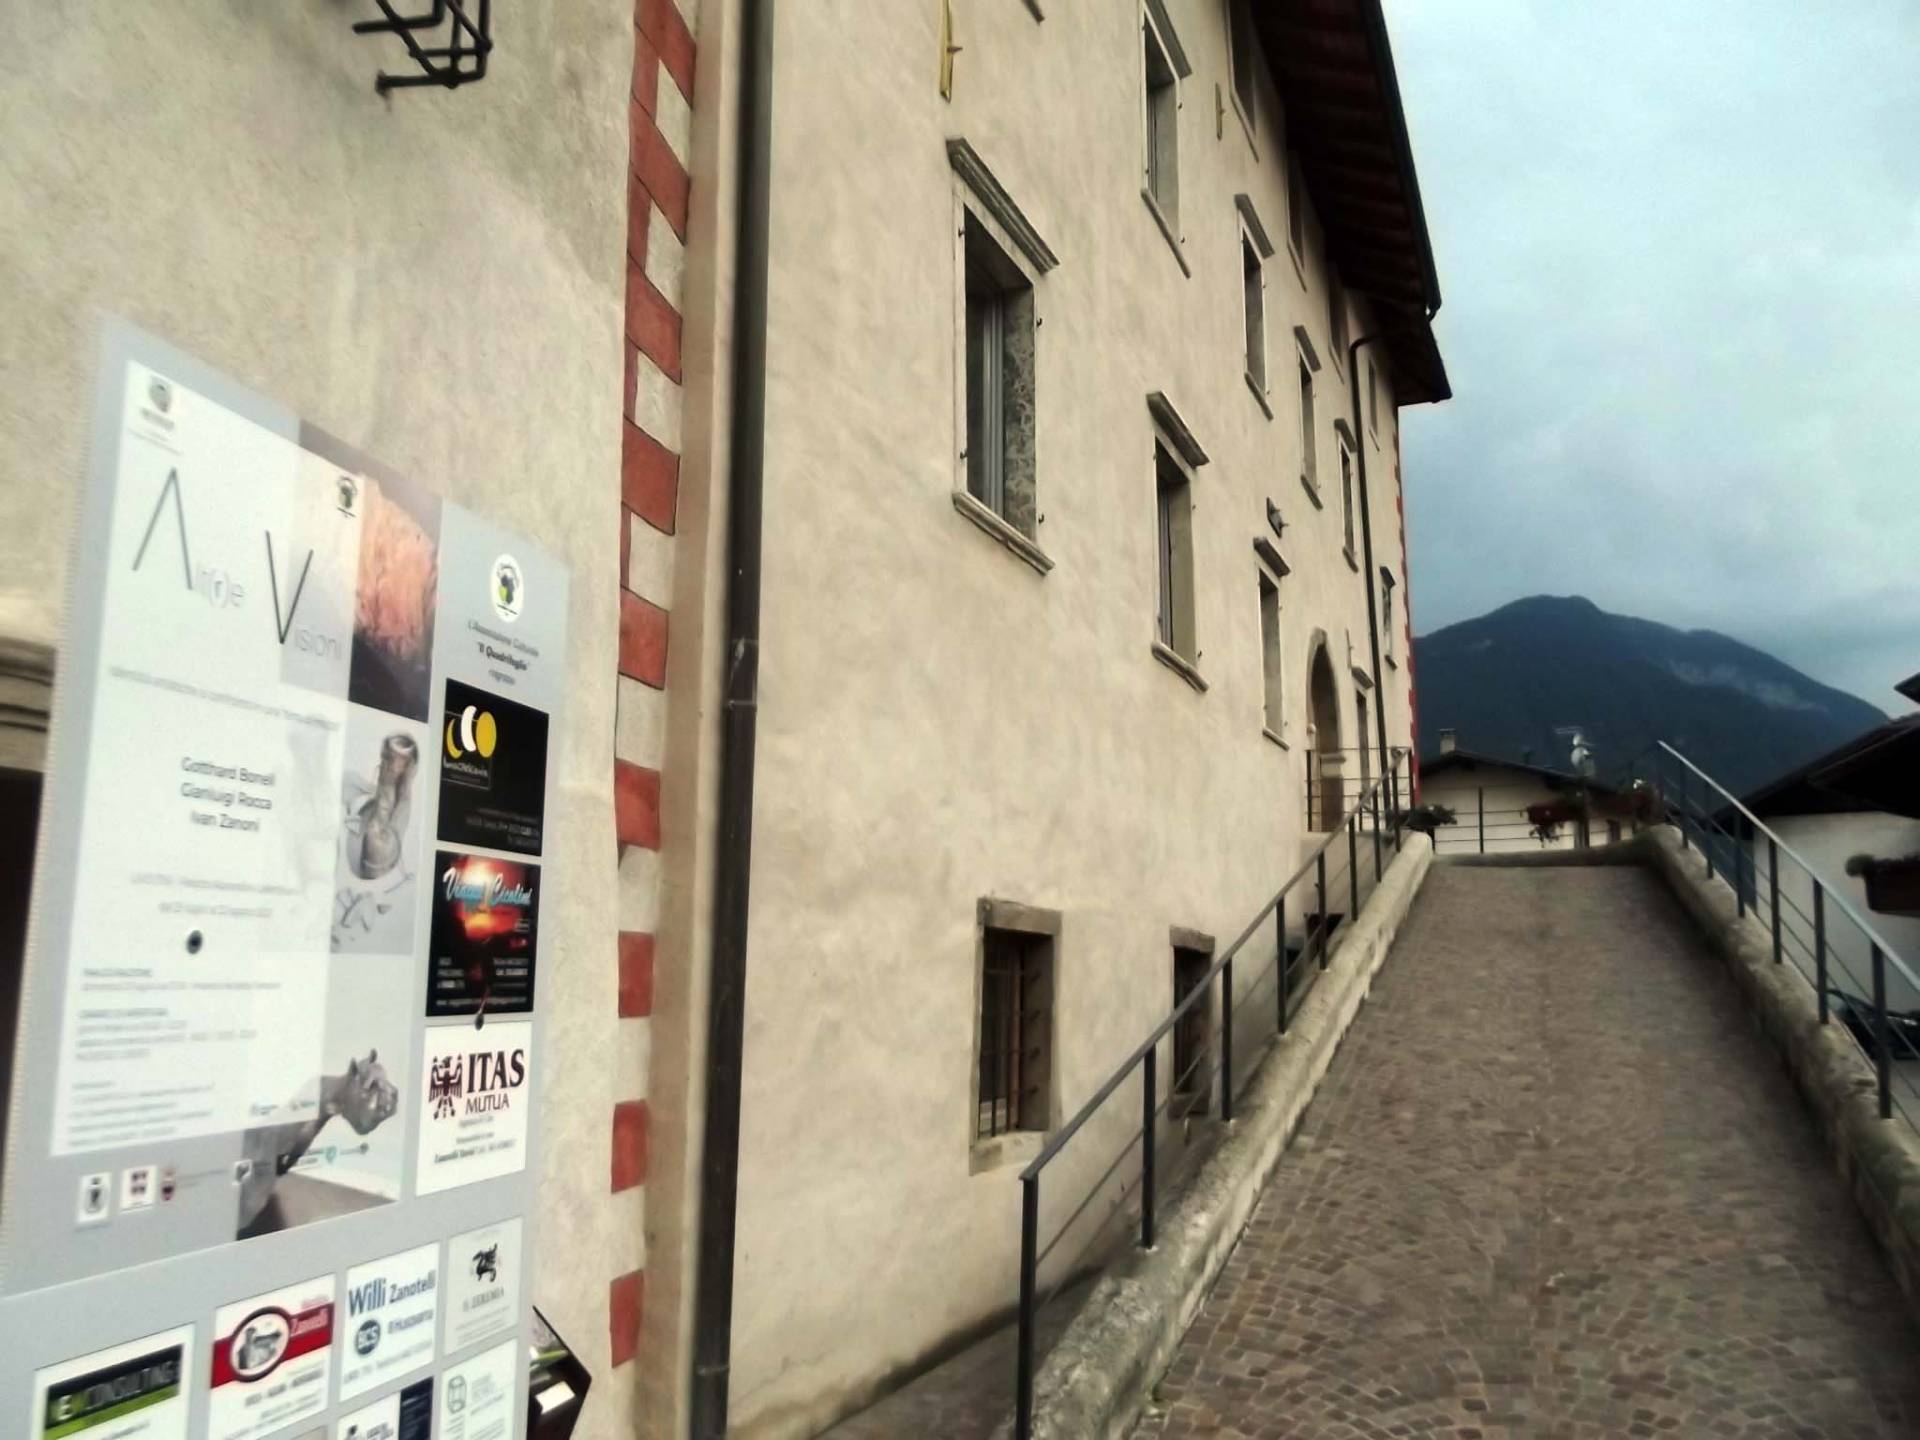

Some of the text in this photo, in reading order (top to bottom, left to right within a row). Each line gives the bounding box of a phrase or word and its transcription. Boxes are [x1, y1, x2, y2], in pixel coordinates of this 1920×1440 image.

[466, 1048, 525, 1094] ITAS
[464, 1093, 510, 1115] MUTUA
[348, 1276, 387, 1317] Willi
